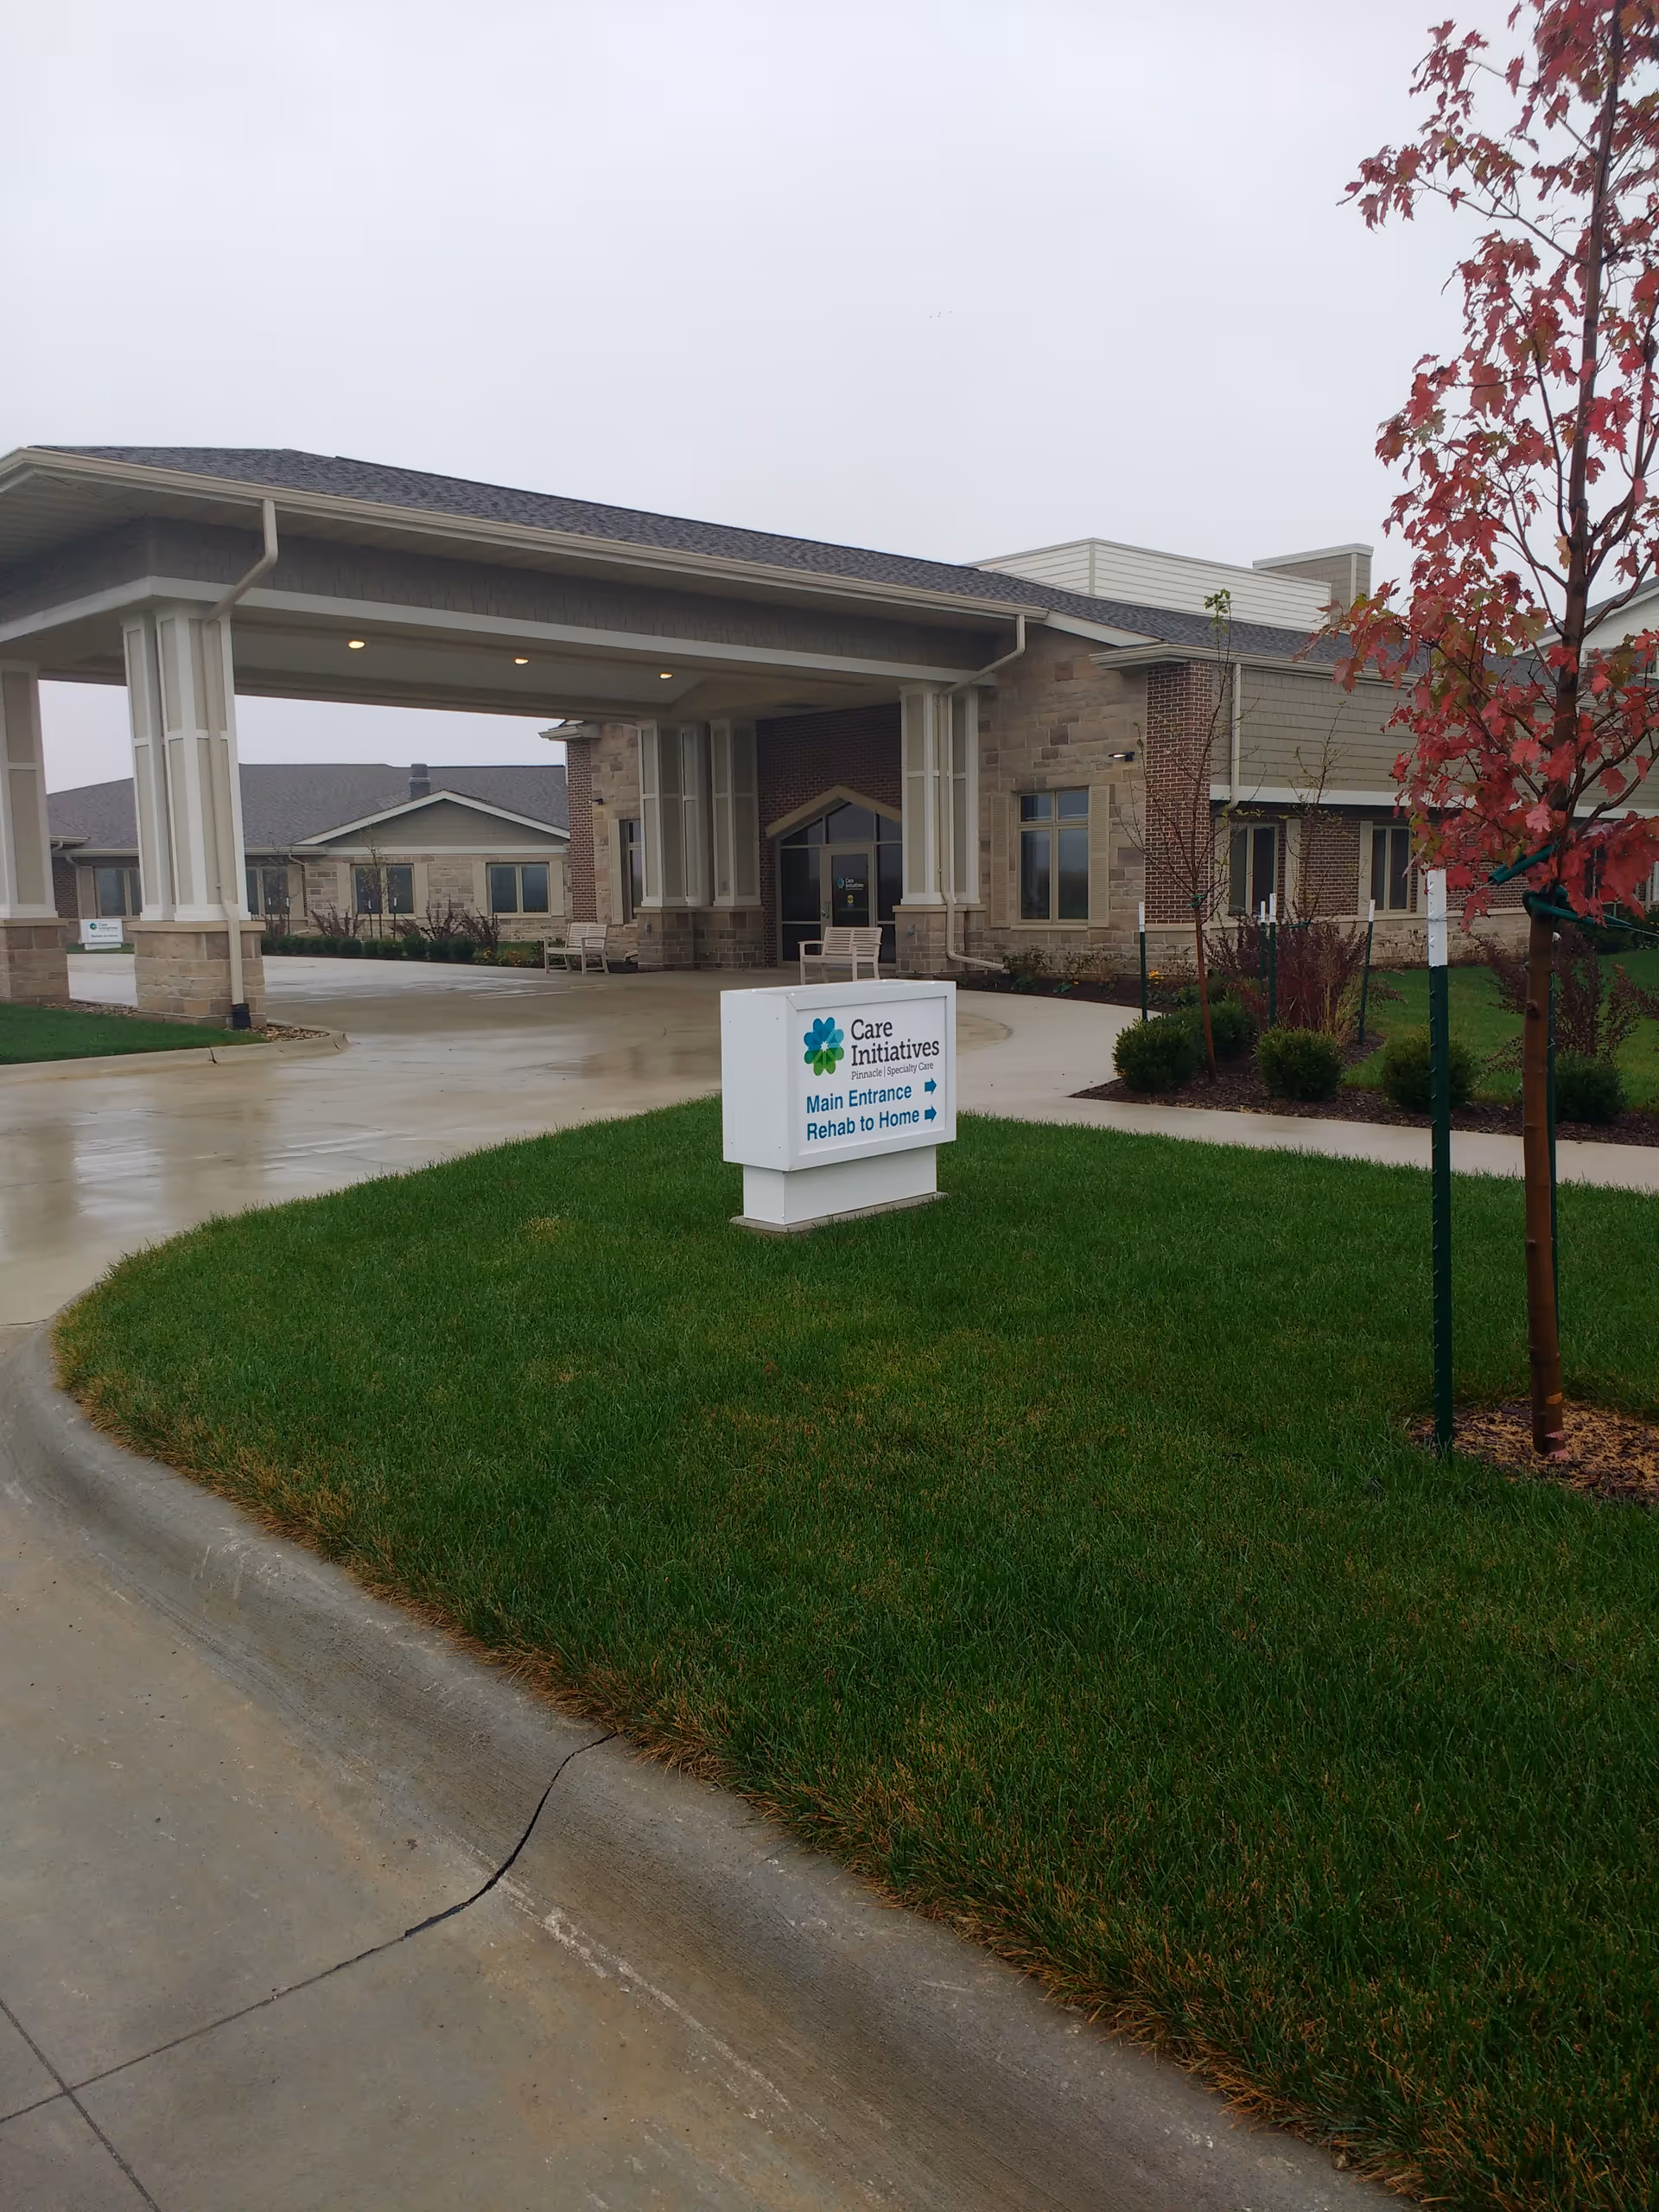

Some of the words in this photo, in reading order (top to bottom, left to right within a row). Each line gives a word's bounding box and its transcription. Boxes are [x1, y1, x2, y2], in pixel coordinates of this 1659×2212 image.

[851, 1019, 893, 1040] Care
[851, 1039, 940, 1066] Initiatives
[851, 1068, 882, 1080] Pinnacle
[887, 1063, 918, 1076] Specialty
[918, 1062, 934, 1071] Care
[806, 1093, 843, 1114] Main
[849, 1085, 912, 1108] Entrance
[807, 1116, 855, 1141] Rehab
[860, 1116, 874, 1131] to
[879, 1109, 920, 1128] Home
